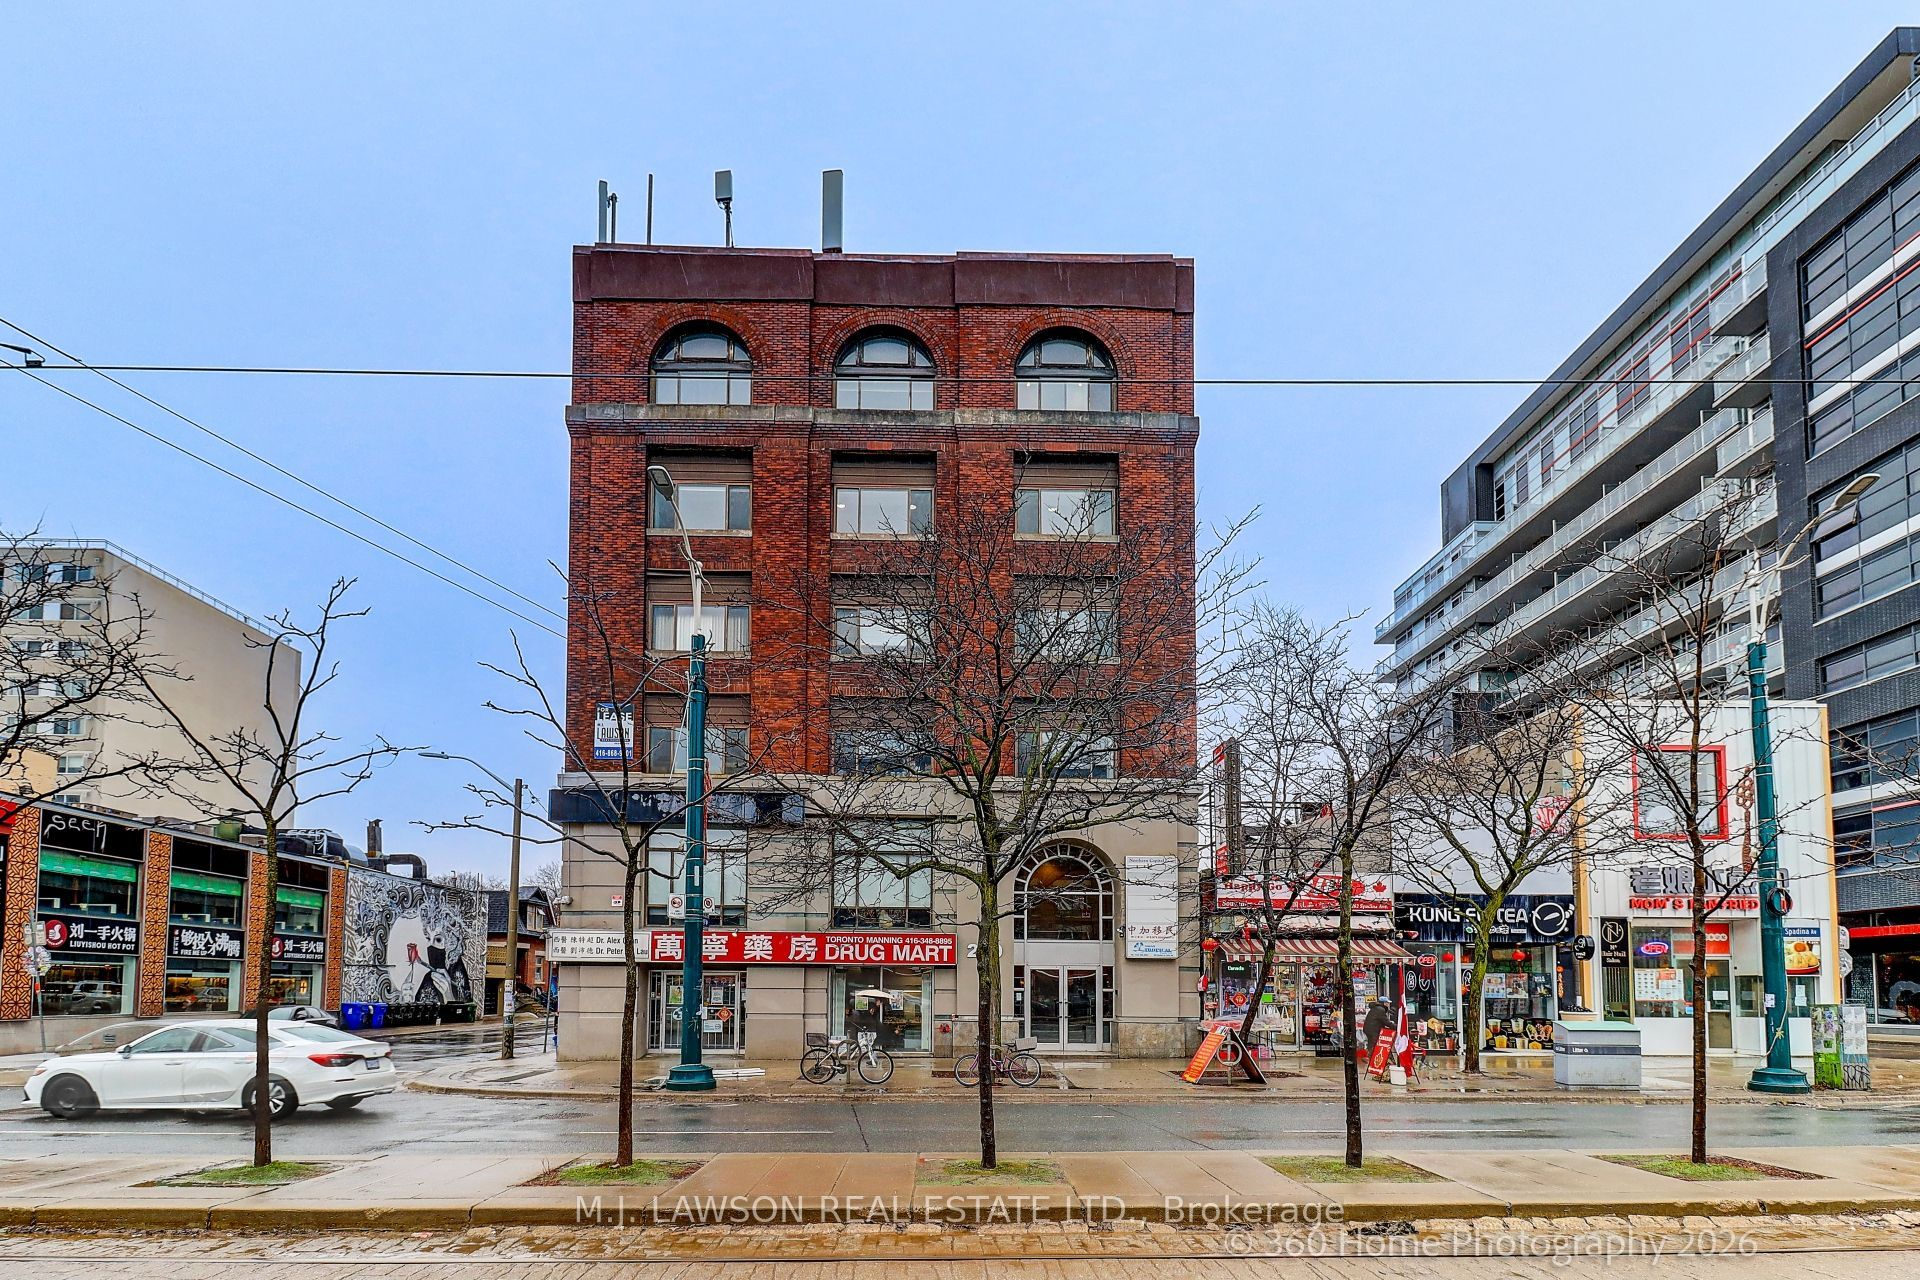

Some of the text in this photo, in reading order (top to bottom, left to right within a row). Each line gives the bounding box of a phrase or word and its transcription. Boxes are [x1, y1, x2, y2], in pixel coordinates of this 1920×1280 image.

[596, 712, 633, 721] LEASE
[596, 727, 630, 739] LAWSN
[595, 749, 632, 757] 416-868-901
[1630, 897, 1684, 911] MOM'S
[1409, 907, 1460, 923] KUNG
[69, 922, 137, 942] 刘一手火锅
[1128, 925, 1176, 936] 中加移民
[1784, 928, 1810, 936] Spadina
[69, 940, 106, 949] LIUYISHOU
[121, 942, 135, 950] POT
[596, 936, 605, 944] Dr.
[606, 936, 621, 944] Alex
[826, 936, 864, 944] TORONTO
[284, 939, 324, 953] 刘一手火锅
[595, 947, 648, 955] Dr. Peter Lau
[1643, 944, 1668, 954] OPEN
[825, 944, 884, 961] DRUG
[892, 945, 953, 962] MART
[1418, 956, 1436, 964] OPEN
